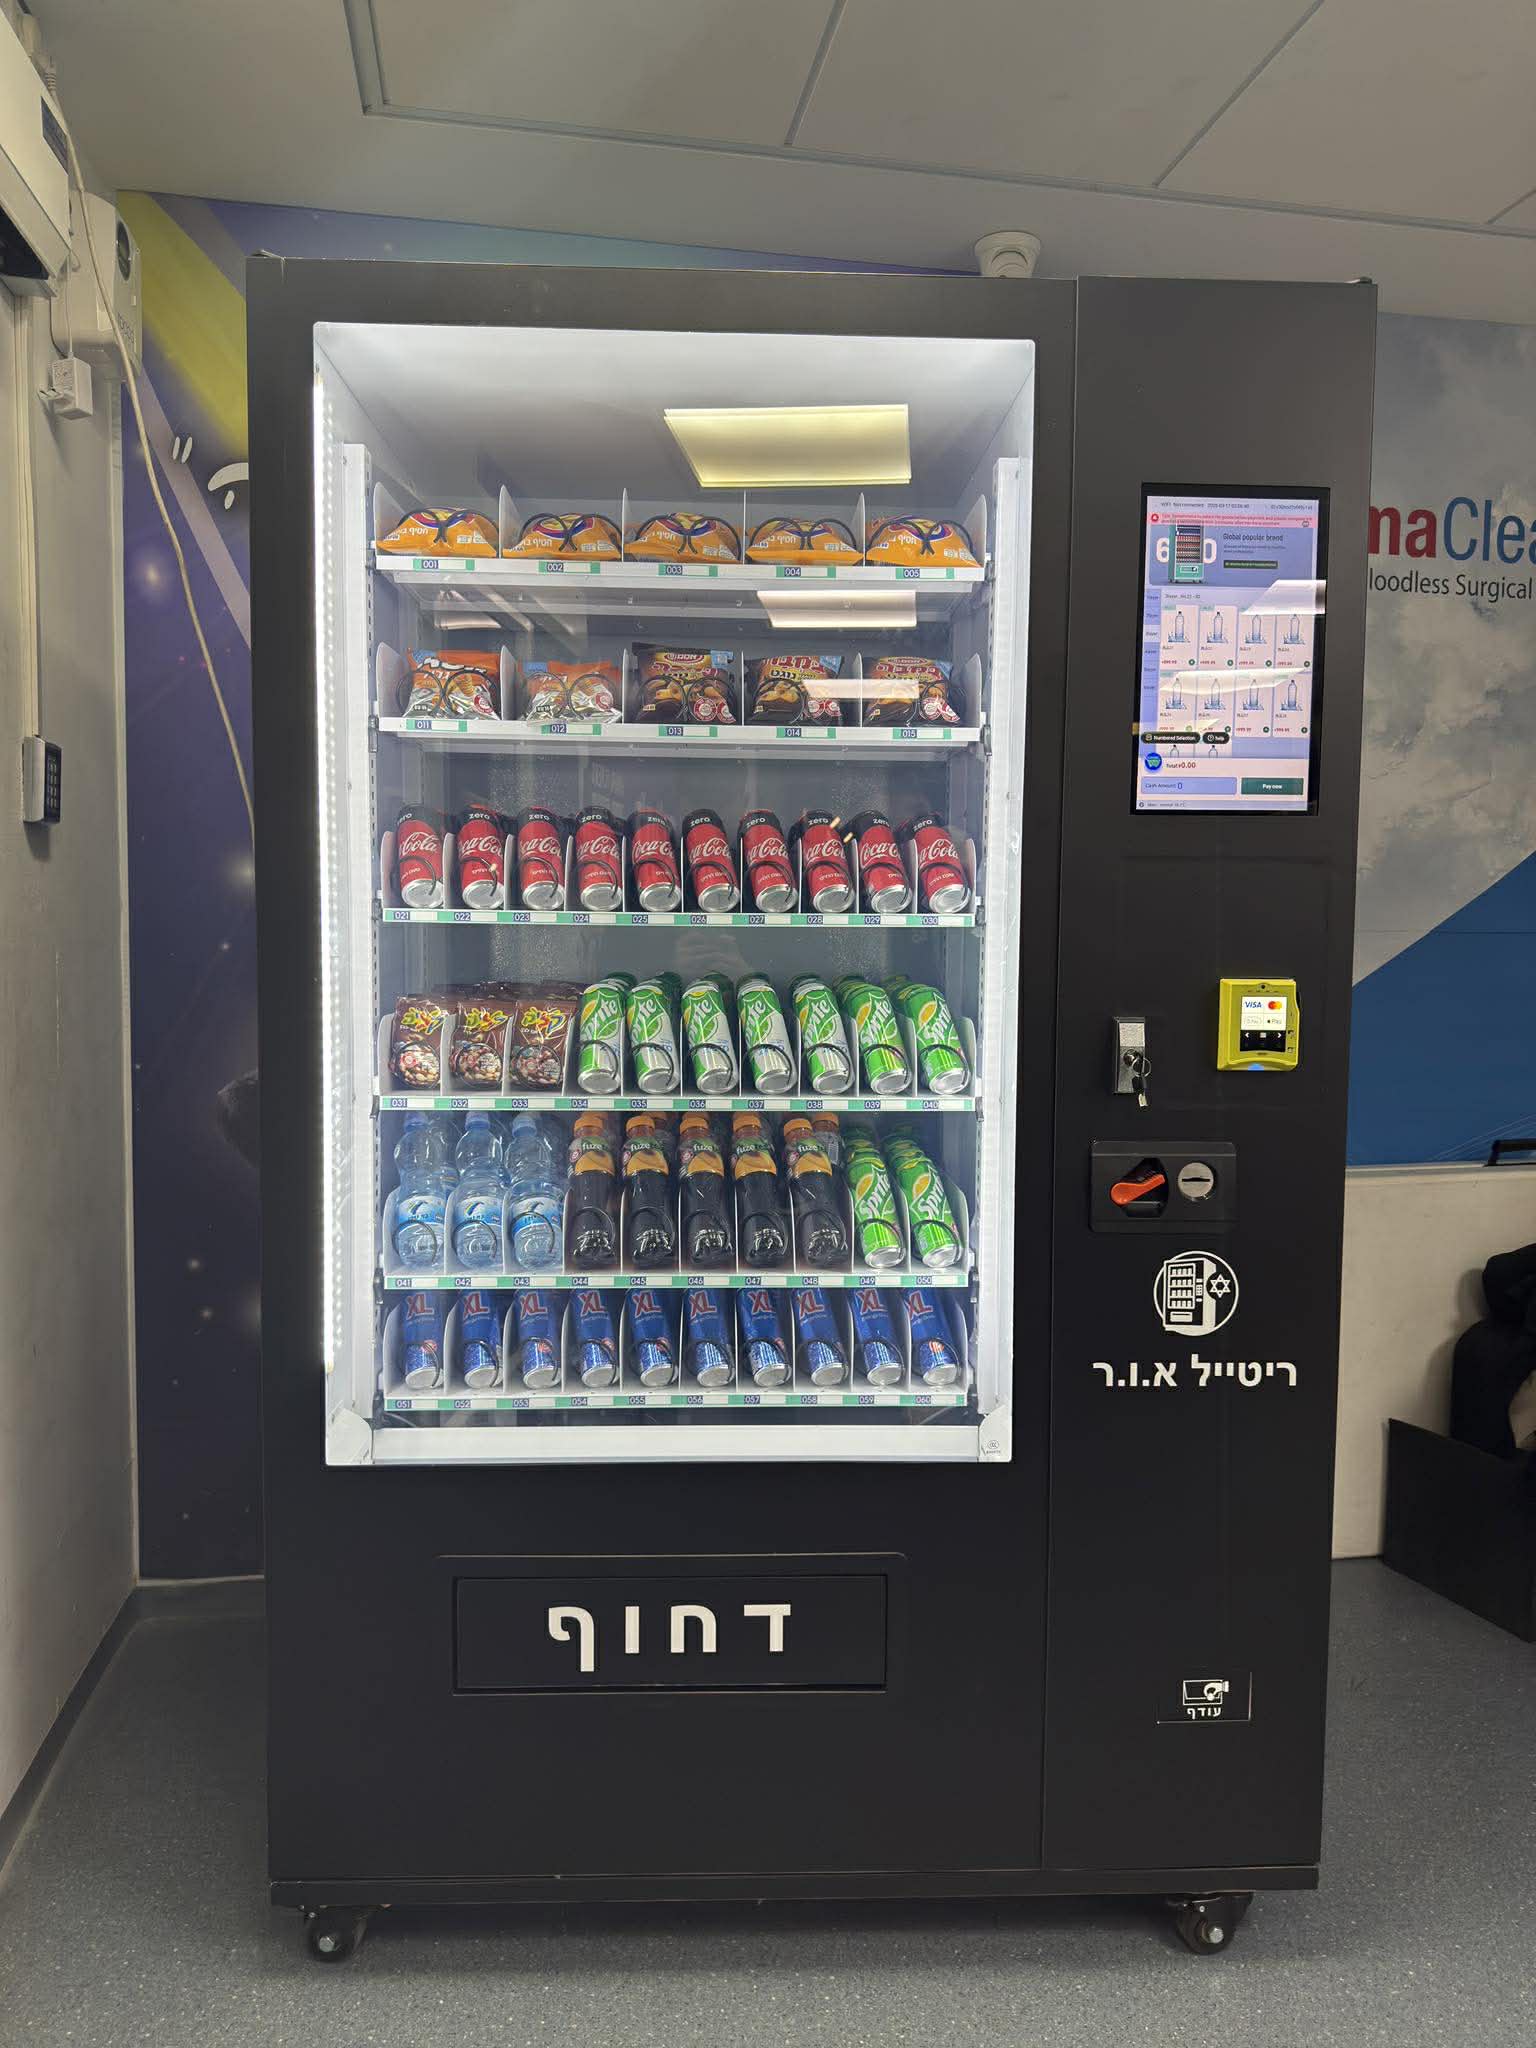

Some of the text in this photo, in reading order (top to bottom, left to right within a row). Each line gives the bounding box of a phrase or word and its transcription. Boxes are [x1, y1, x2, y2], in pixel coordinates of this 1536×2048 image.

[1242, 534, 1264, 542] popular
[422, 560, 438, 569] 001
[547, 563, 563, 572] 002
[667, 566, 682, 574] 003
[785, 568, 801, 576] 004
[904, 569, 919, 577] 005
[1456, 575, 1532, 603] Surgical
[416, 720, 429, 729] 011
[551, 724, 564, 733] 012
[787, 728, 800, 736] 014
[690, 817, 711, 826] zero
[746, 817, 766, 828] zero
[913, 819, 932, 831] zero
[515, 913, 529, 921] 023
[632, 915, 648, 923] 025
[691, 915, 706, 923] 026
[808, 916, 822, 924] 028
[865, 916, 880, 924] 029
[632, 1100, 646, 1108] 035
[456, 1278, 470, 1286] 042
[515, 1278, 529, 1286] 043
[573, 1278, 587, 1286] 044
[631, 1278, 646, 1286] 045
[803, 1277, 818, 1285] 048
[579, 1291, 607, 1317] XL
[632, 1291, 662, 1318] XL
[690, 1291, 717, 1318] XL
[748, 1290, 776, 1314] XL
[798, 1290, 824, 1318] XL
[856, 1289, 887, 1313] XL
[906, 1290, 933, 1318] XL
[407, 1293, 434, 1320] XL
[464, 1292, 489, 1319] XL
[520, 1292, 547, 1319] XL
[1093, 1353, 1297, 1387] ריטייל א.ו.ר
[573, 1398, 587, 1406] 054
[630, 1397, 644, 1405] 055
[746, 1396, 760, 1404] 057
[802, 1396, 817, 1404] 058
[860, 1396, 874, 1404] 059
[916, 1396, 931, 1404] 060
[396, 1401, 411, 1409] 051
[548, 1604, 791, 1672] דחוף
[1187, 1707, 1221, 1719] עודף
